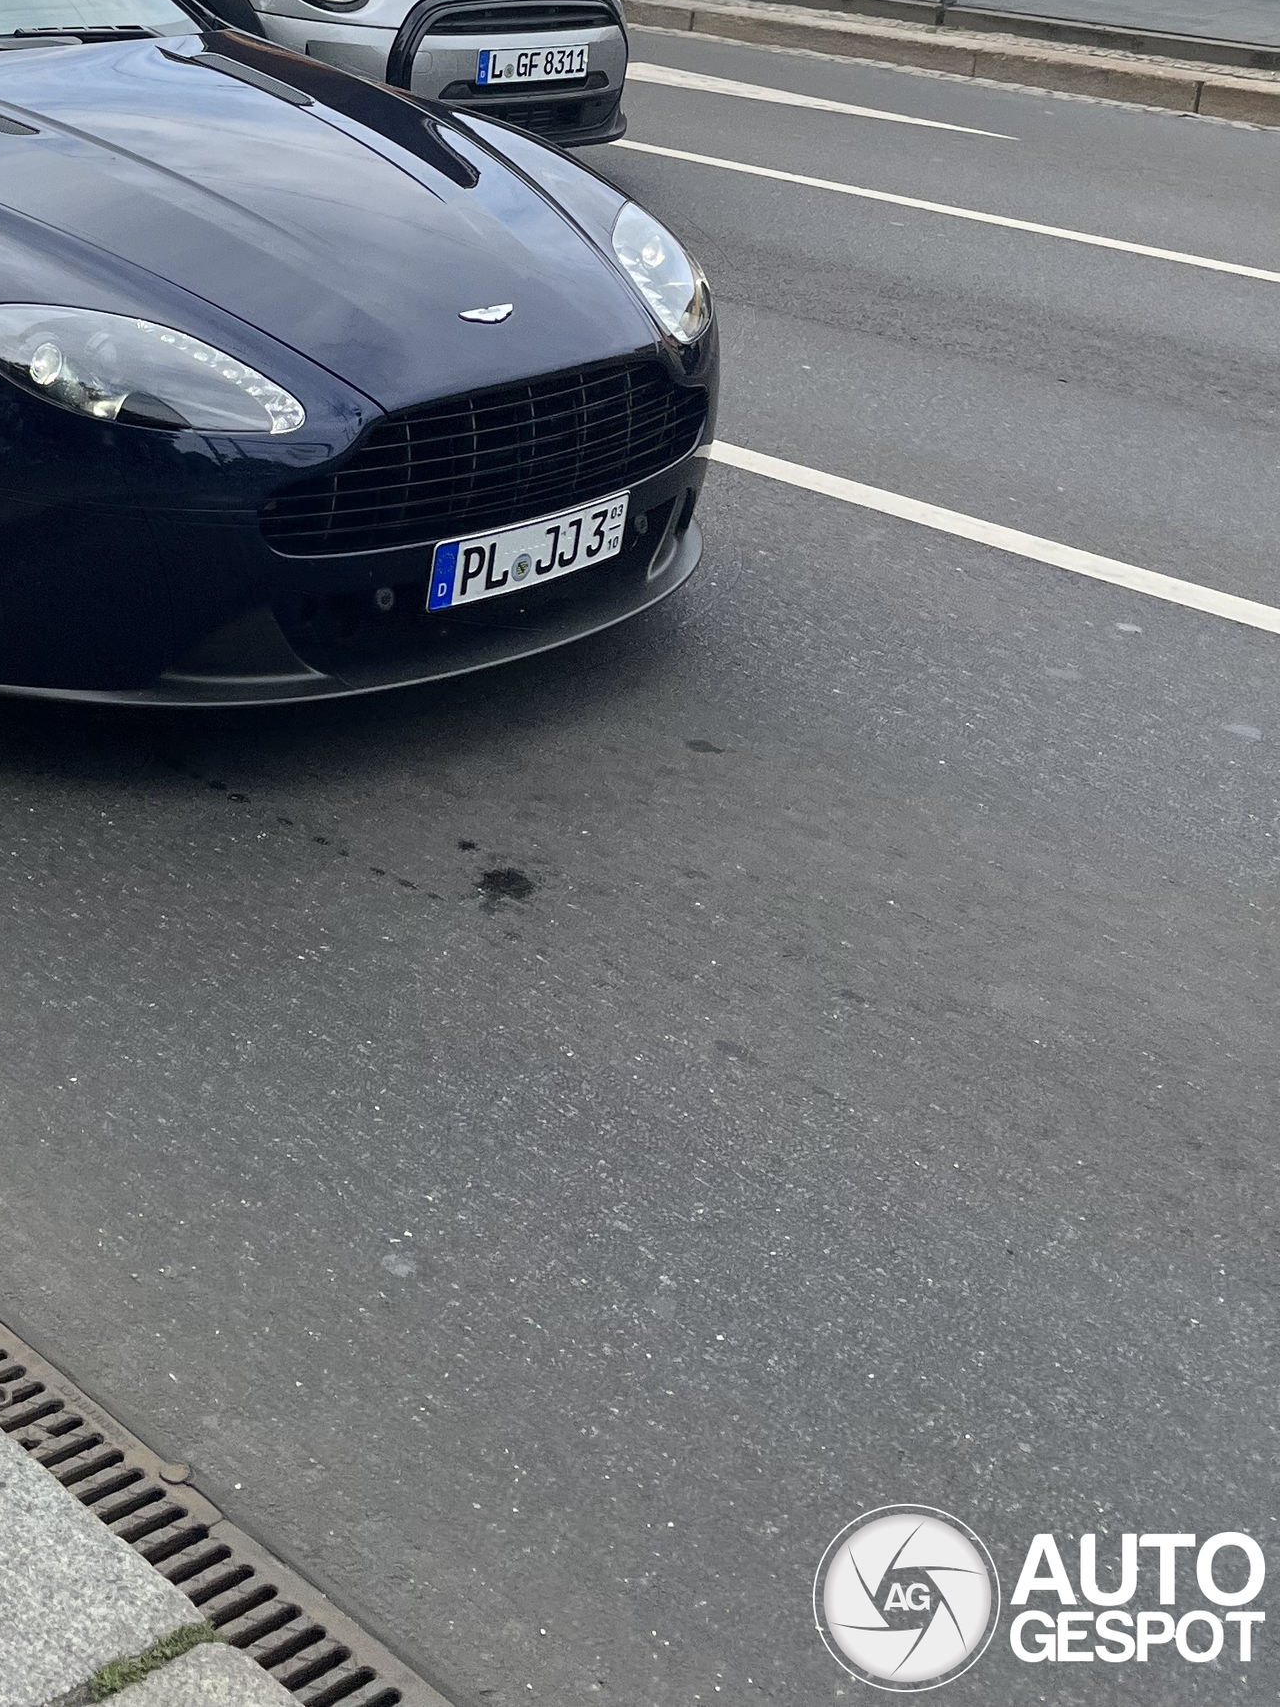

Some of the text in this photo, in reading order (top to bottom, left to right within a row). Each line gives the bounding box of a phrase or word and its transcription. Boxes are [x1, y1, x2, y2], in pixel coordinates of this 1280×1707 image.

[491, 53, 503, 79] L
[516, 51, 542, 77] GF
[543, 48, 585, 76] 8311
[610, 504, 624, 520] 03
[437, 582, 447, 597] D
[460, 542, 509, 596] PL
